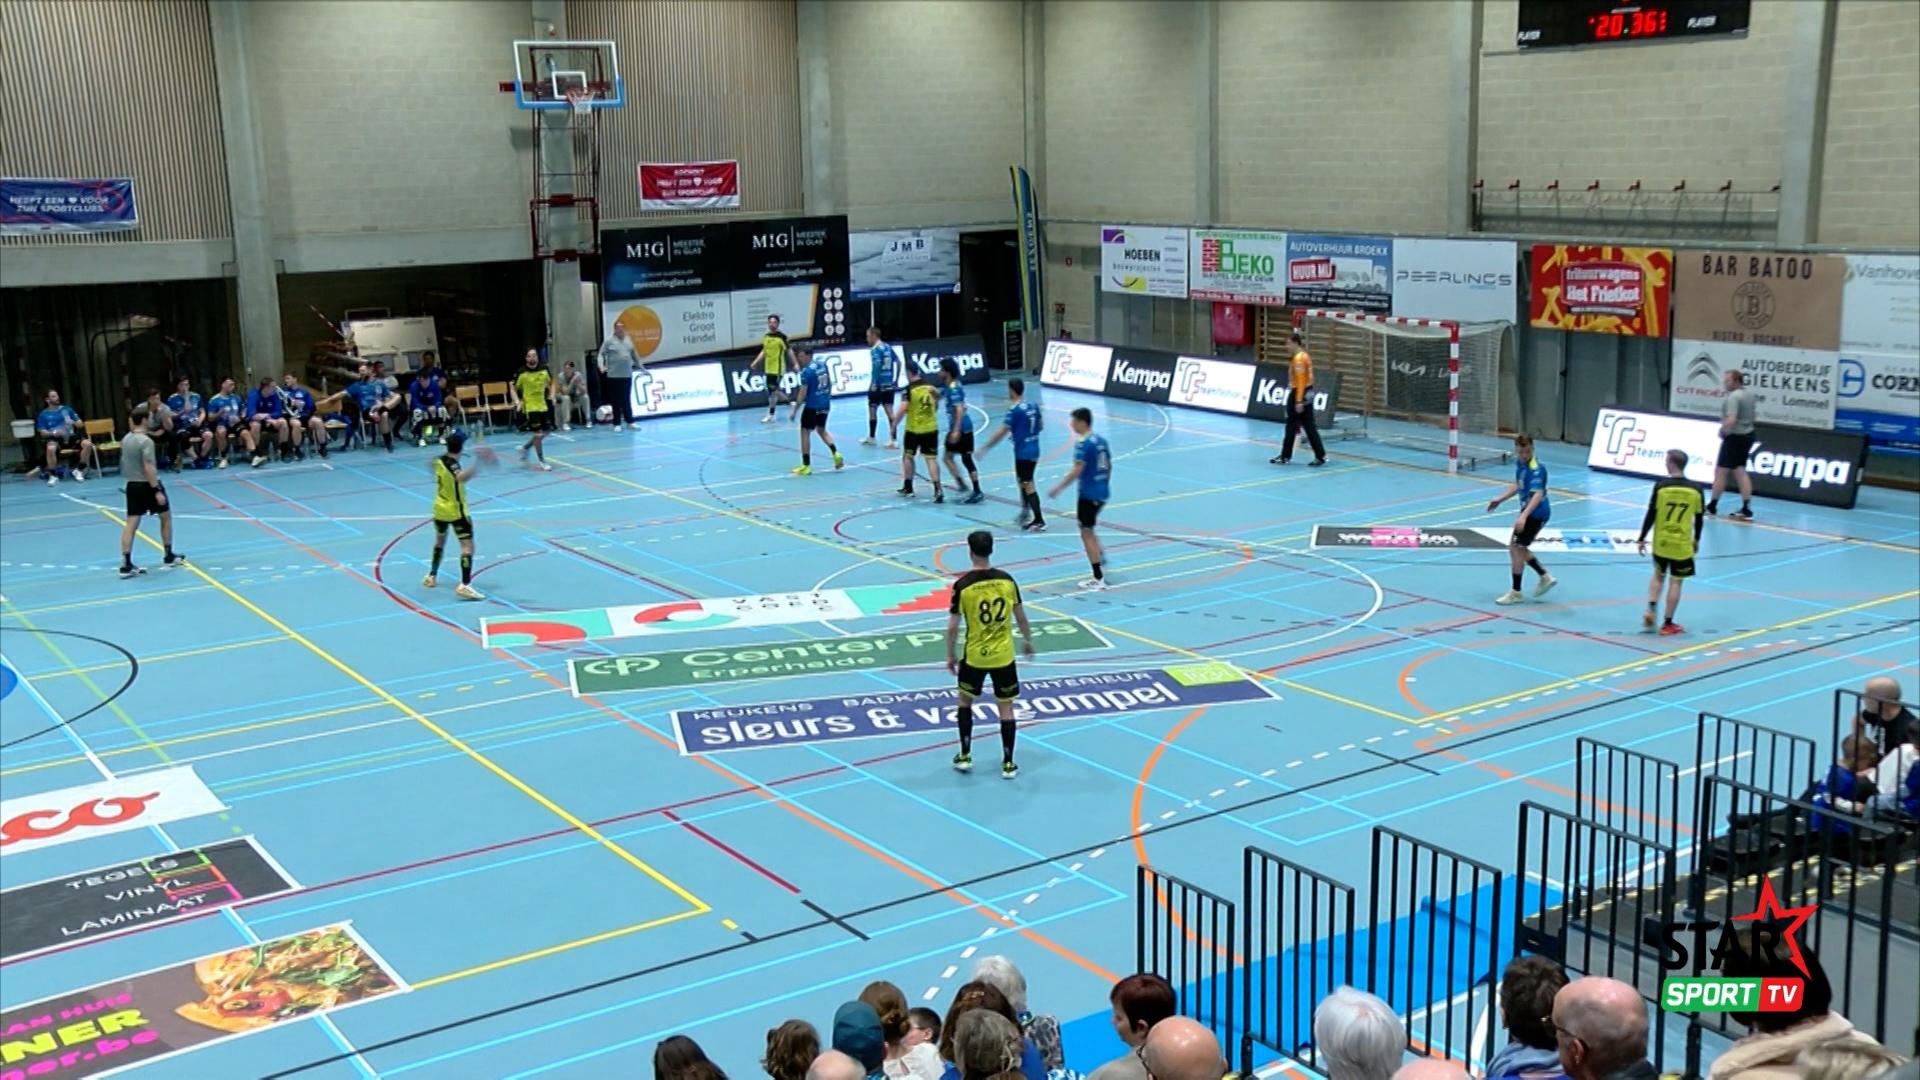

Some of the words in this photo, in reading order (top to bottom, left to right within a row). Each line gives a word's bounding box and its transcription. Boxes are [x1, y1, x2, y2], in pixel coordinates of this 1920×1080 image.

[1687, 15, 1717, 28] PLAYER
[44, 196, 65, 204] EEN
[1124, 248, 1161, 262] HOEBEN
[1290, 241, 1353, 255] AUTOVERHUUR
[1702, 255, 1738, 276] BAR
[1748, 256, 1813, 280] BATOO
[699, 301, 714, 309] Uw
[1566, 285, 1588, 301] Het
[683, 312, 715, 322] Elektro
[689, 322, 715, 332] Groot
[683, 333, 716, 344] Handel
[911, 351, 984, 376] Kepa
[1112, 359, 1171, 392] Kempa
[1741, 358, 1832, 376] AUTOBEDRIJF
[731, 370, 801, 394] Kep
[1742, 373, 1831, 394] GIELKENS
[1256, 378, 1329, 411] Kea
[1782, 395, 1830, 410] Lommel
[1666, 502, 1689, 524] 77
[979, 597, 1006, 625] 82
[682, 636, 896, 667] Center
[905, 623, 1080, 648] Pcs
[693, 703, 814, 720] KEUKENS
[843, 686, 996, 708] BADKAMES
[1023, 672, 1153, 691] INTERIEUR
[700, 714, 857, 745] sleurs
[866, 707, 905, 729] &
[913, 681, 1180, 724] vangompel
[65, 858, 180, 891] TEGELS
[105, 876, 191, 902] VINYL
[61, 894, 208, 937] LAMINAAT
[0, 1014, 53, 1037] AN
[60, 992, 133, 1020] HUIS
[0, 1008, 150, 1064] NER
